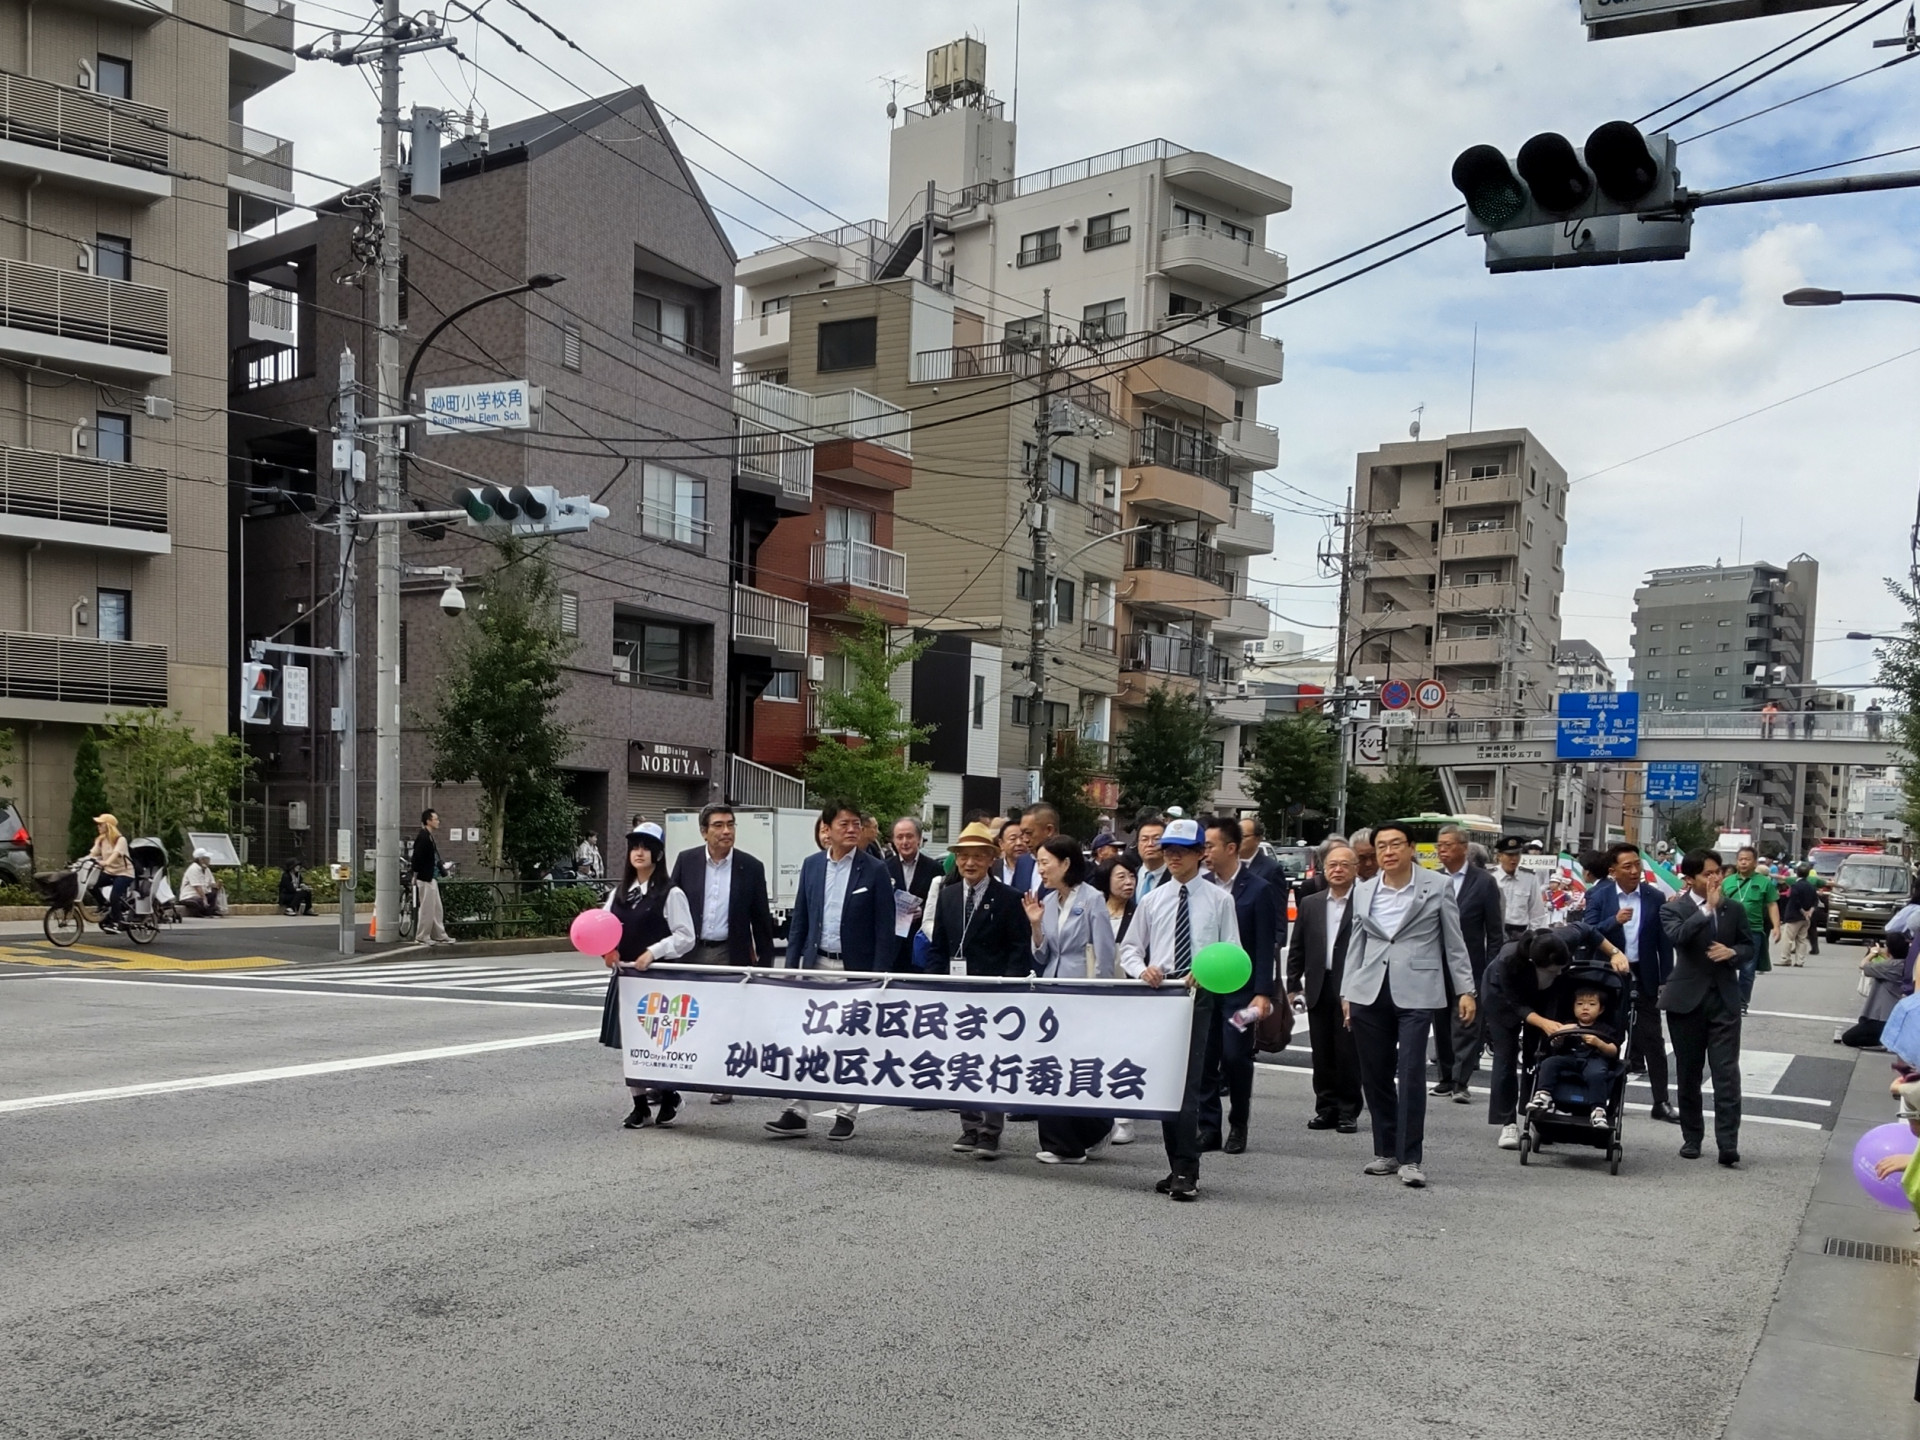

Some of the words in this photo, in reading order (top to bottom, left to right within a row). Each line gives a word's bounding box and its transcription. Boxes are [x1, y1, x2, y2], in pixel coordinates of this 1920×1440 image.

[431, 389, 522, 412] 砂町小学校角
[432, 414, 476, 426] Sunamachi
[479, 412, 500, 423] Elem.
[504, 410, 522, 421] Sch.
[1422, 688, 1439, 701] 40
[1613, 718, 1635, 729] 亀戸
[641, 754, 704, 775] NOBUYA.
[637, 992, 699, 1018] SPORTS
[802, 999, 1060, 1043] 江東区民まつり
[630, 1048, 650, 1059] KOTO
[666, 1051, 698, 1063] TOKYO
[725, 1041, 1148, 1101] 砂町地区大会実行委員会
